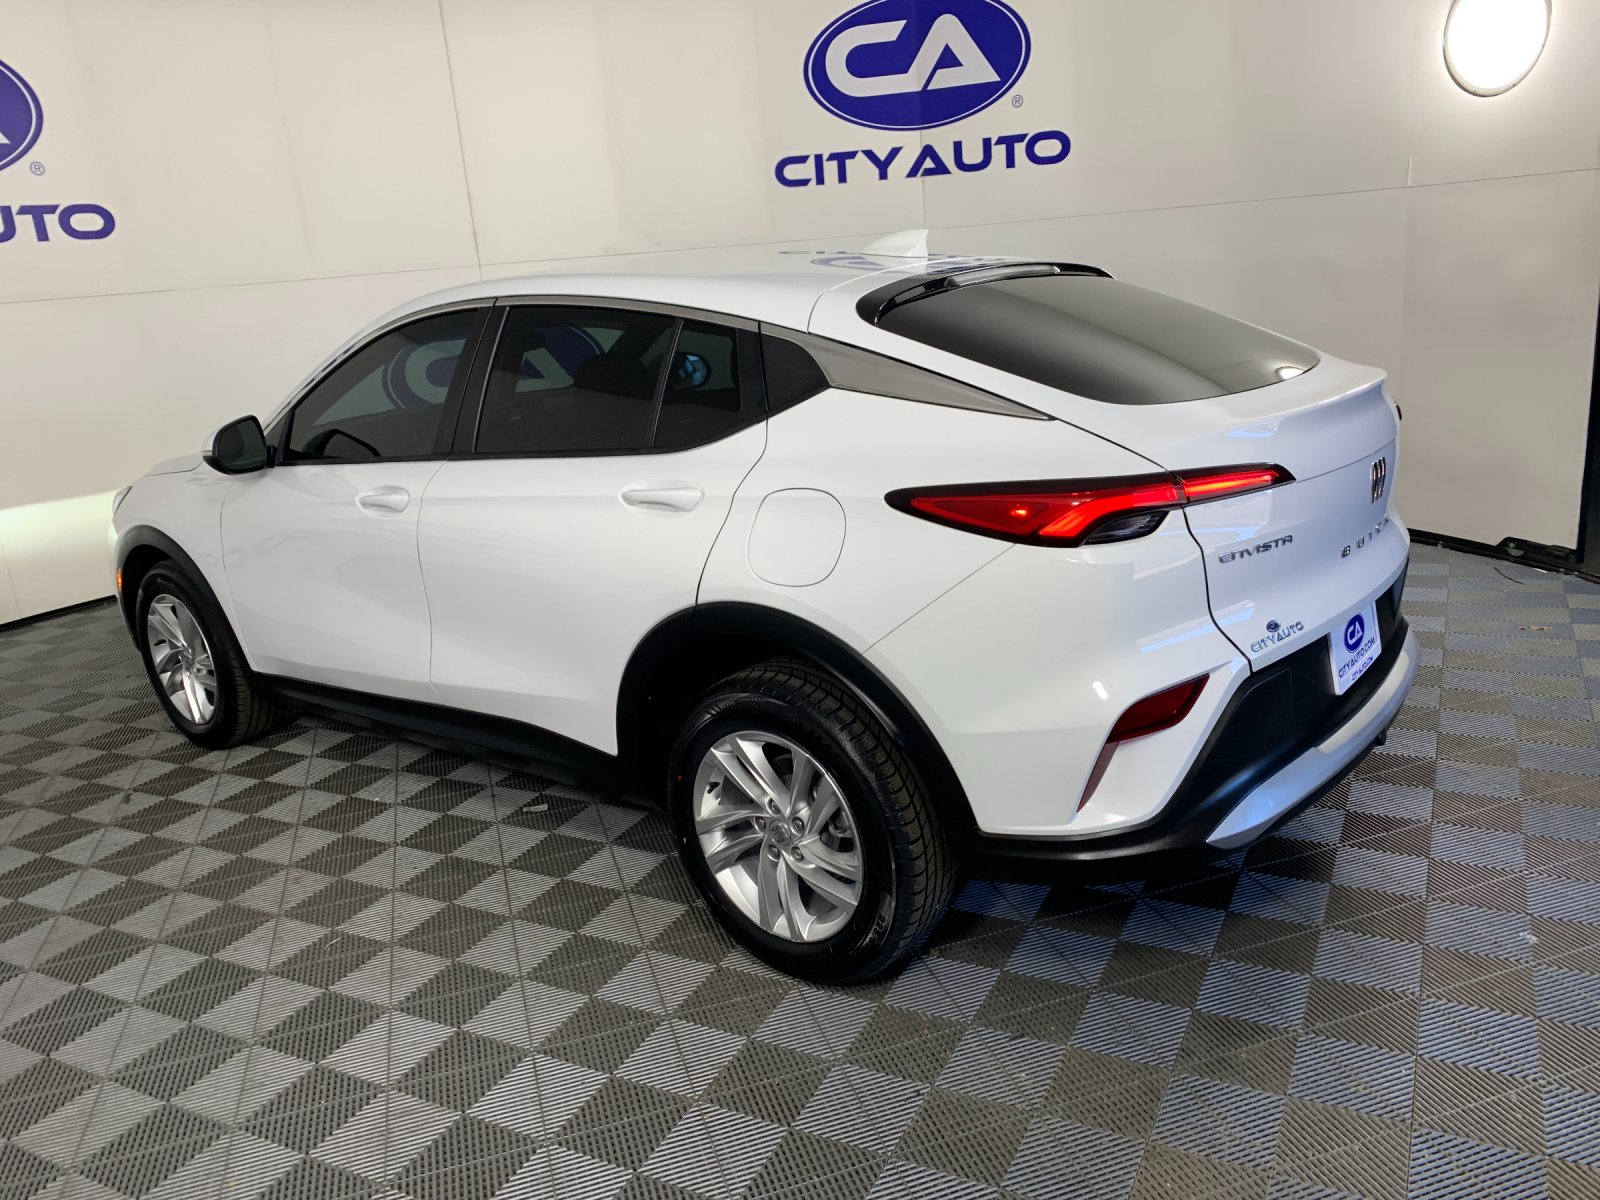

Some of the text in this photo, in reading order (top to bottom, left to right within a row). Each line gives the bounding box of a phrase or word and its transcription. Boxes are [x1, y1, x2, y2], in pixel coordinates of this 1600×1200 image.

[825, 13, 1002, 97] CA
[1219, 534, 1293, 563] ENVISTA
[1346, 620, 1363, 646] CA
